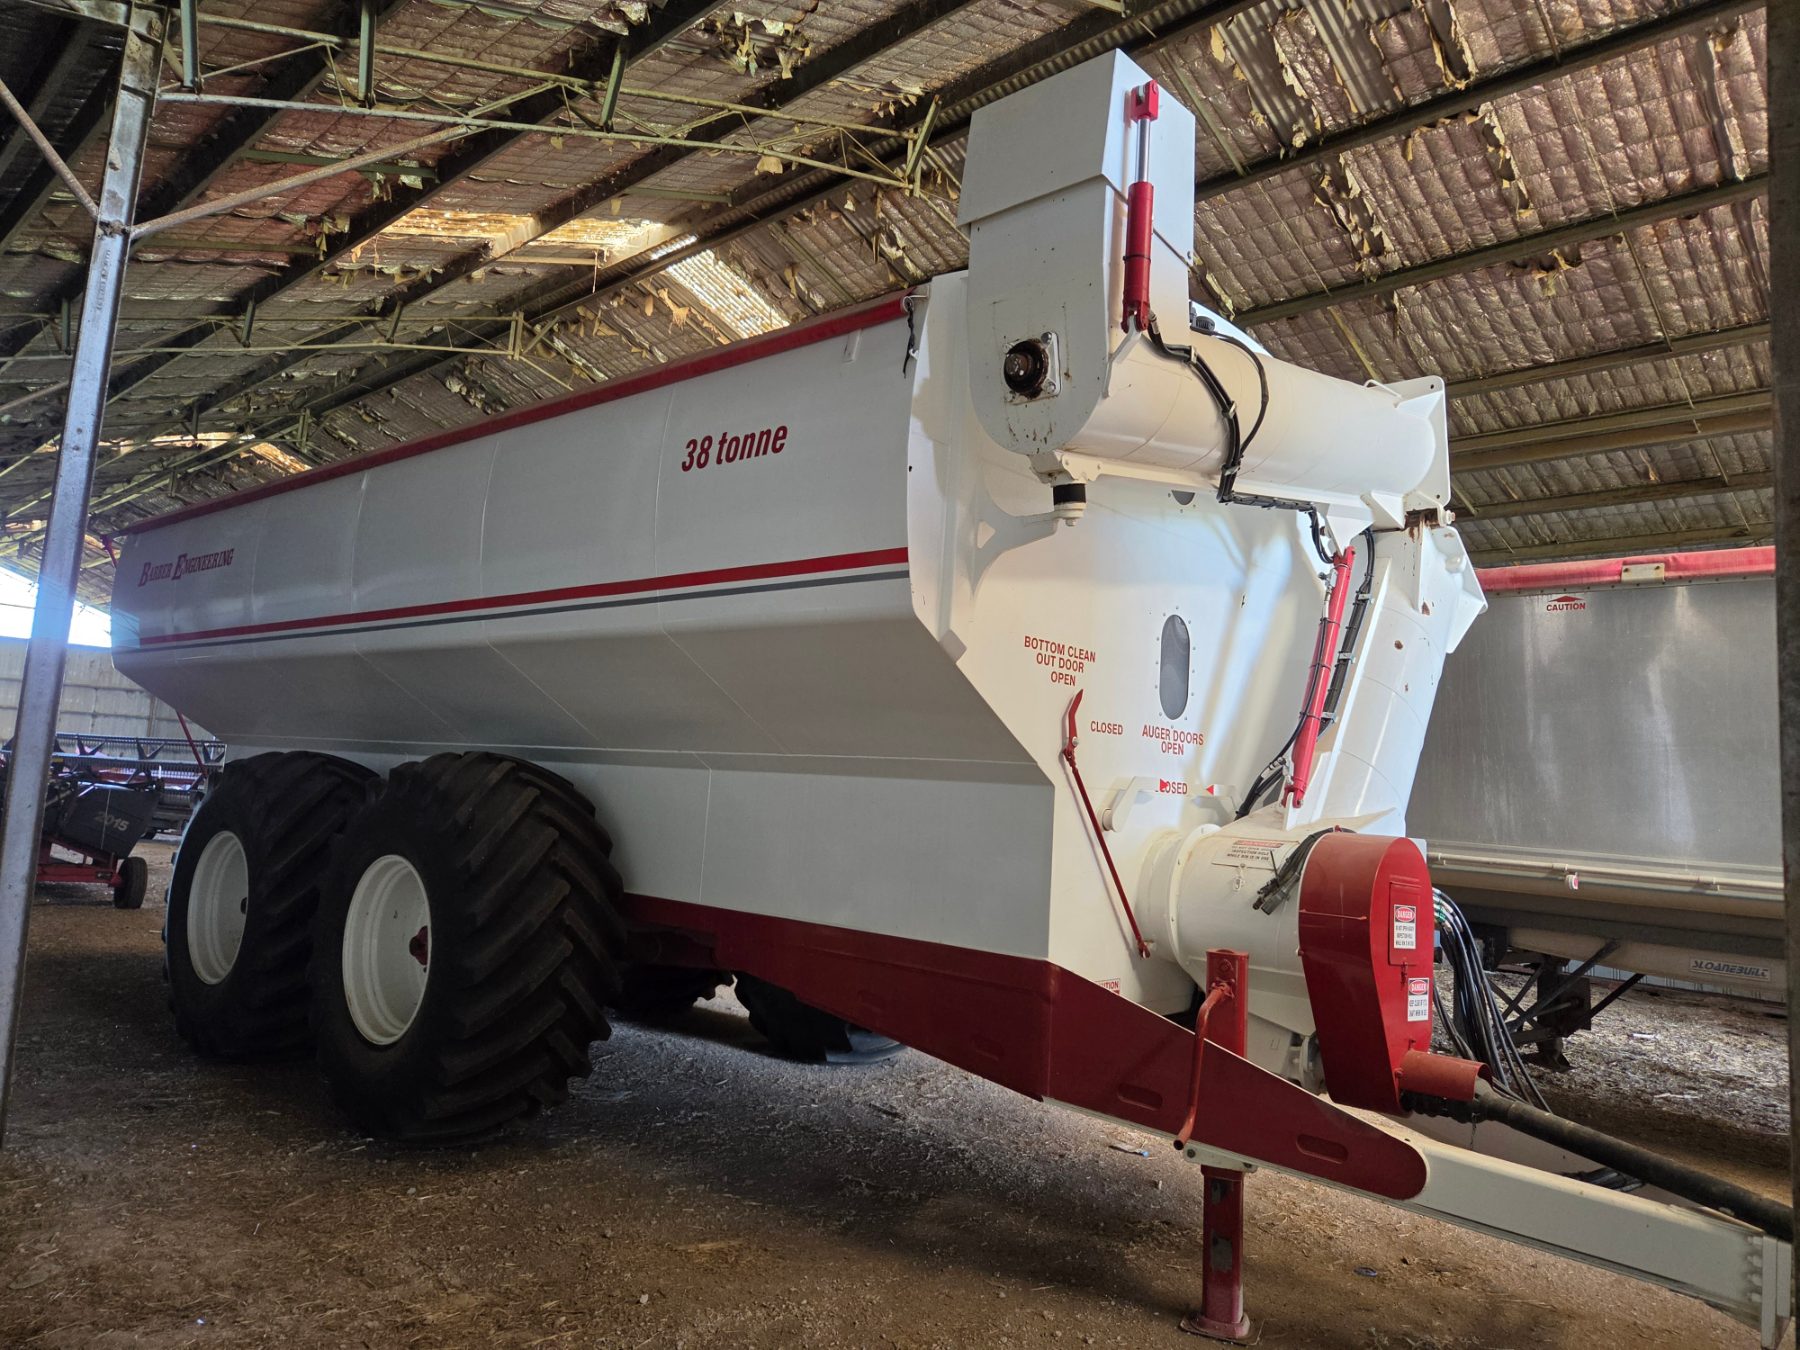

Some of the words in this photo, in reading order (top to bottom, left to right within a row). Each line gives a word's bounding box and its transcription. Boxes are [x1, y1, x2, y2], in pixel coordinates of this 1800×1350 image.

[681, 435, 713, 472] 38
[716, 425, 788, 465] tonne
[1546, 602, 1586, 611] CAUTION
[1024, 635, 1065, 655] BOTTOM
[1067, 646, 1096, 662] CLEAN
[1036, 652, 1057, 667] OUT
[1058, 657, 1085, 673] DOOR
[1050, 671, 1076, 686] OPEN
[1090, 720, 1124, 735] CLOSED
[1142, 724, 1171, 741] AUGER
[1172, 730, 1204, 746] DOORS
[1161, 741, 1184, 756] OPEN
[1157, 780, 1188, 795] OSED
[93, 811, 130, 831] 2015
[1397, 910, 1414, 919] DANGER
